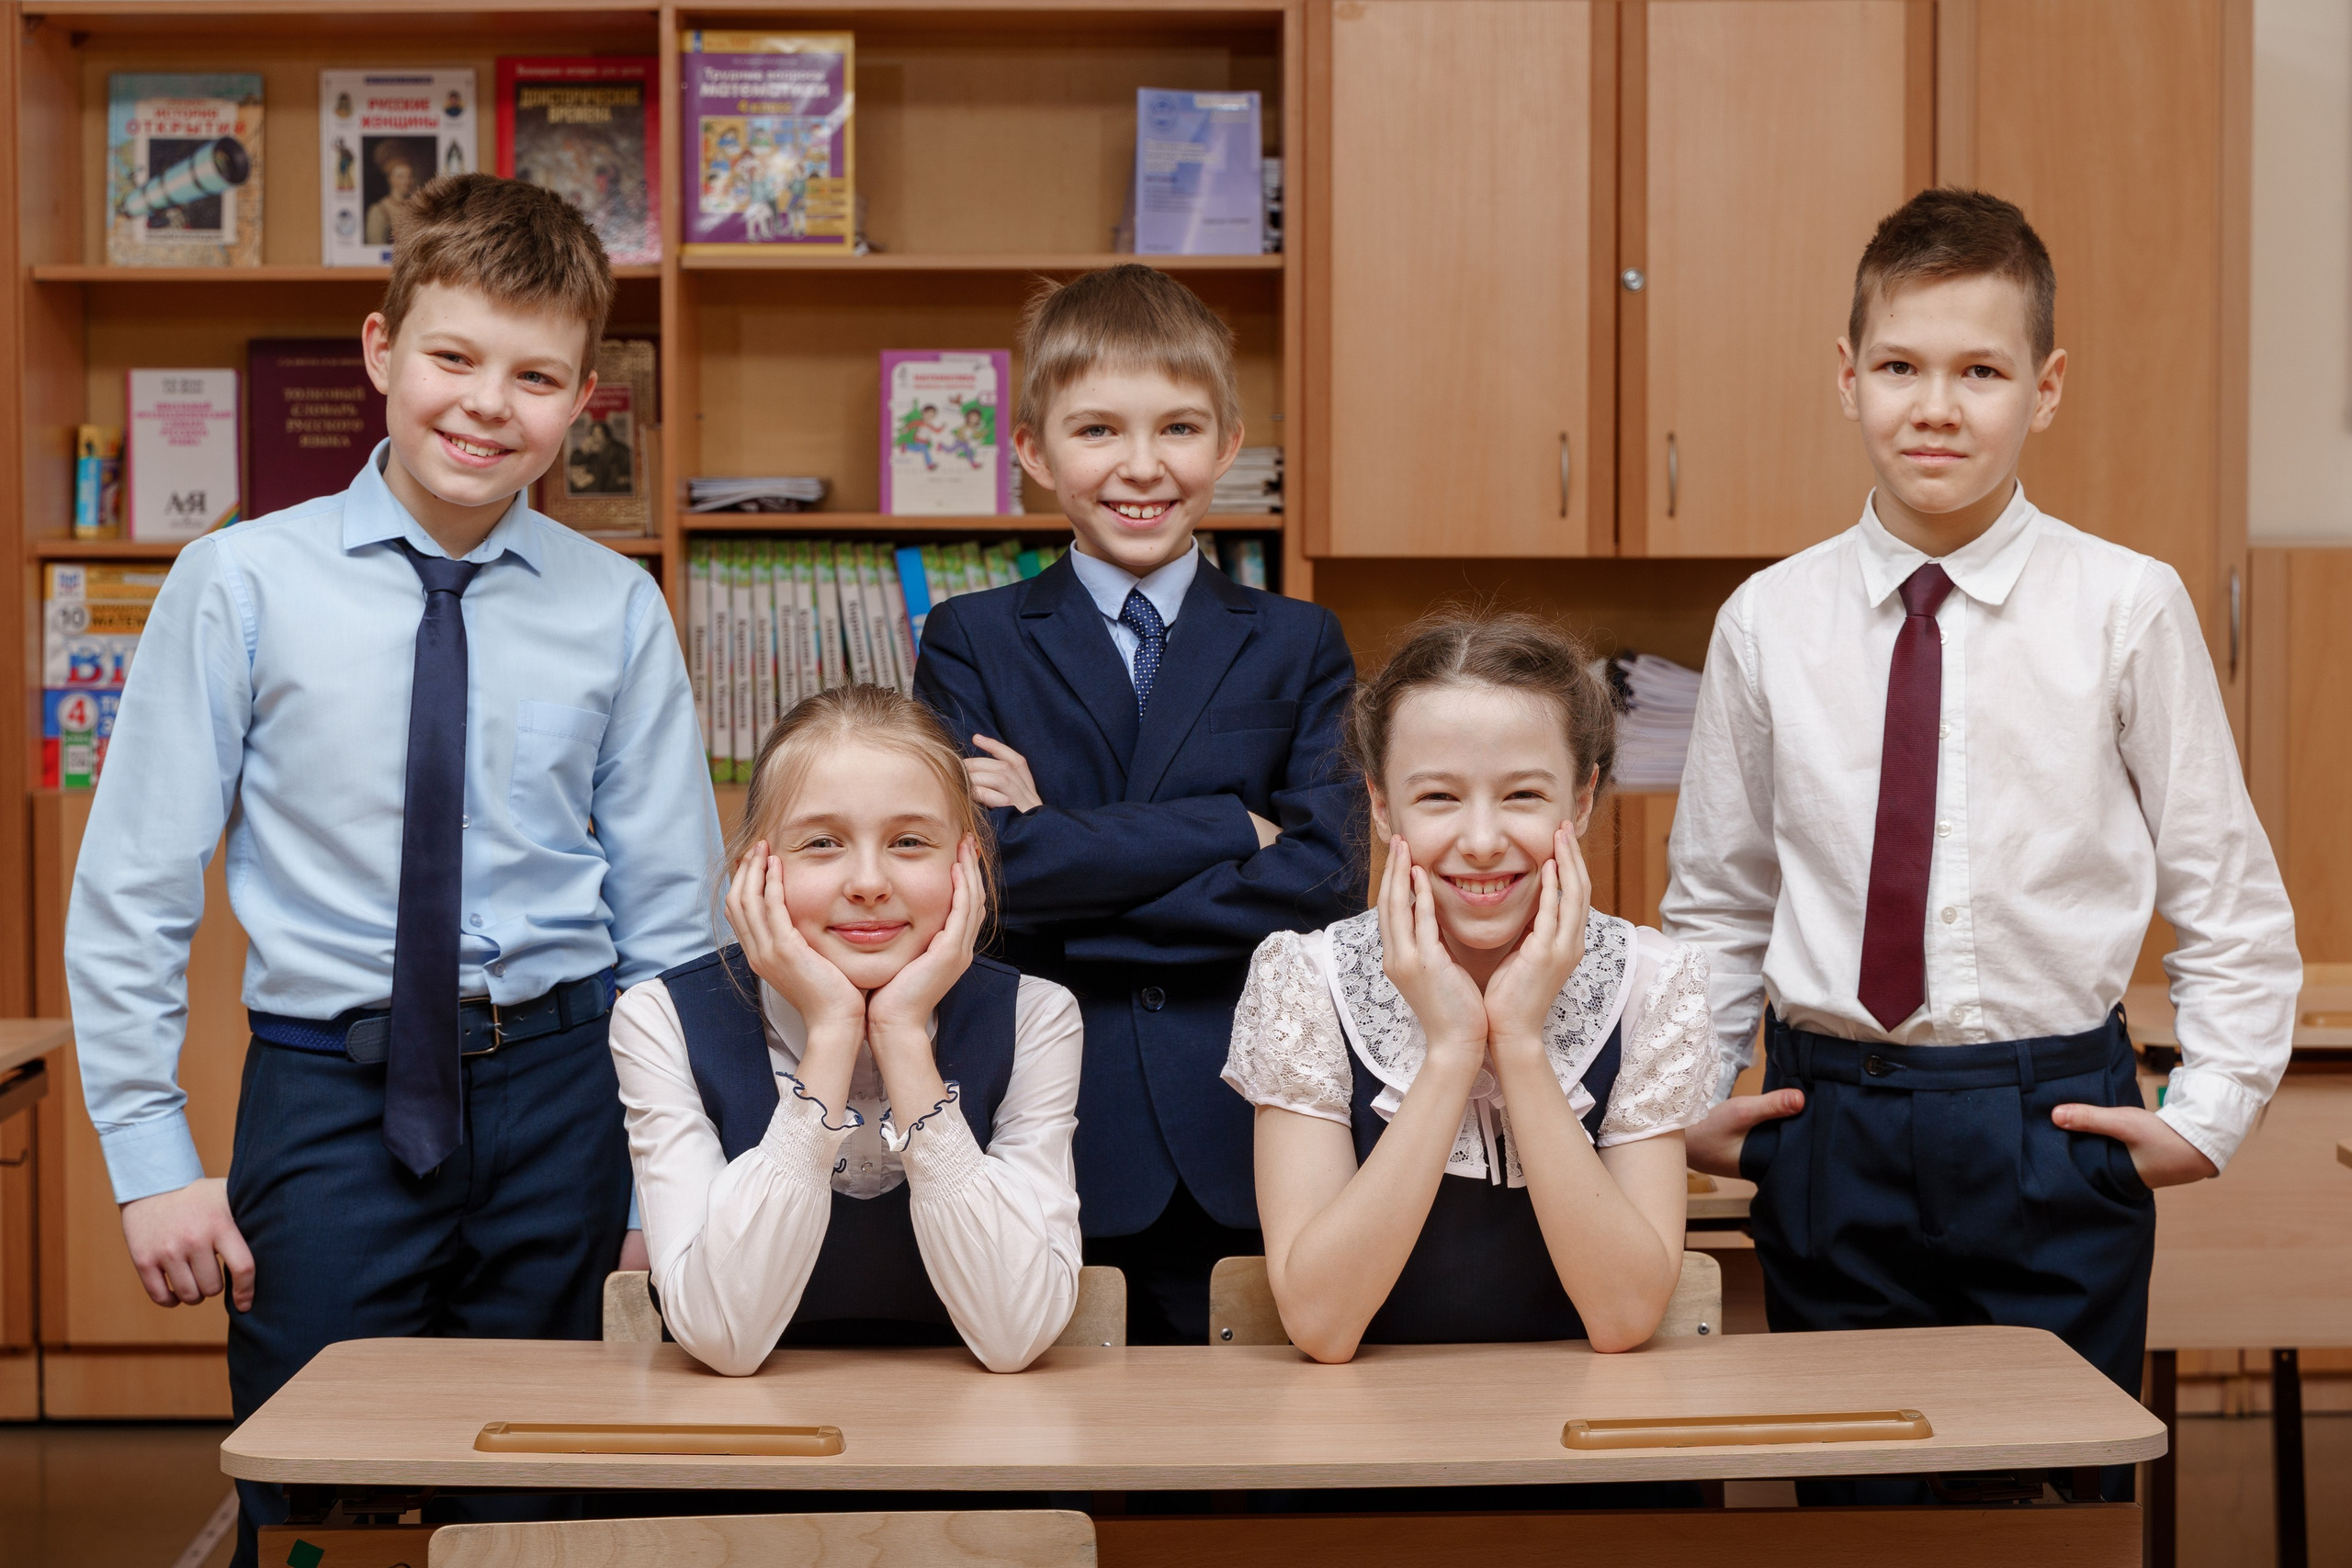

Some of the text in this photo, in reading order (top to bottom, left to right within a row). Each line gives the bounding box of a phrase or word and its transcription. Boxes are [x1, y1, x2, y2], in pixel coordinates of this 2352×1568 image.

[704, 66, 763, 81] Трудные
[368, 97, 431, 111] РУССКИЕ
[360, 116, 440, 130] ЖЕНЩИНЫ
[284, 385, 366, 401] ТОЛКОВЫЙ
[290, 402, 358, 417] СЛОВАРЬ
[286, 417, 365, 433] РУССКОГО
[299, 434, 351, 448] ЯЗЫКА
[60, 607, 85, 625] 10
[68, 698, 86, 727] 4
